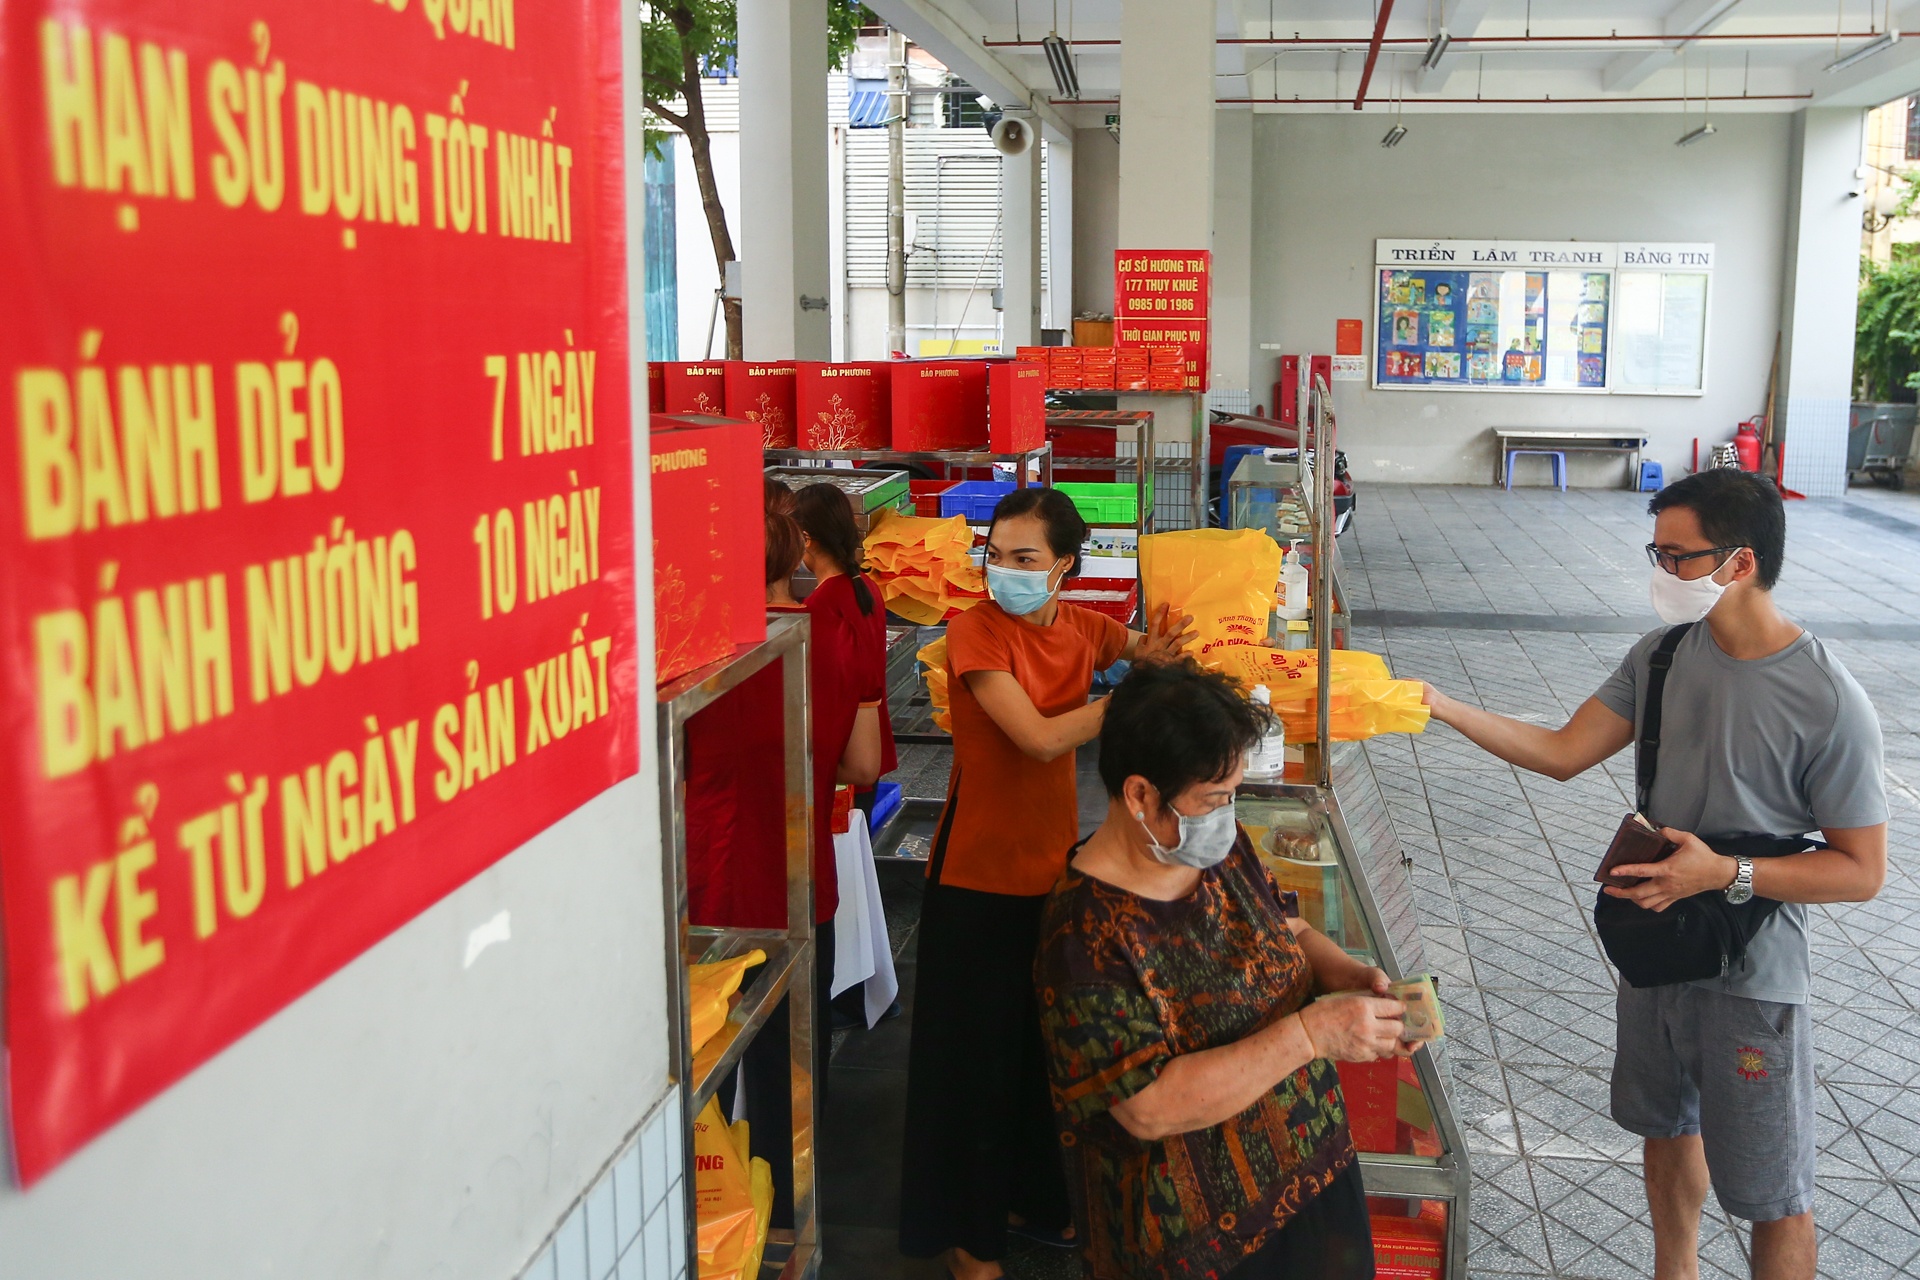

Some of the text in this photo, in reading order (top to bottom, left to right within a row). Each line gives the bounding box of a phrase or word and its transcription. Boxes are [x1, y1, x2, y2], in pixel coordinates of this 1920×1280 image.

[42, 20, 572, 249] HẠN SỬ DỤNG TỐT NHẤT
[1392, 243, 1603, 263] TRIỂN LÃM TRANH
[1624, 247, 1709, 265] BẢNG TIN
[1118, 256, 1205, 272] CƠ SỞ HƯƠNG TRÀ
[1125, 277, 1198, 294] 177 THỤY KHUÊ
[1128, 298, 1194, 310] 0985 00 1986
[1122, 327, 1200, 344] THỜI GIAN PHỤC VỤ
[686, 365, 705, 376] BẢO
[749, 366, 766, 376] BẢO
[821, 366, 871, 377] BẢO PHƯƠNG
[920, 367, 934, 378] BẢO
[486, 330, 595, 460] 7 NGÀY
[19, 313, 343, 539] BÁNH DẺO
[651, 448, 708, 474] PHƯƠNG
[474, 508, 516, 619] 10
[524, 471, 600, 603] NGÀY
[35, 517, 418, 779] BÁNH NƯỚNG
[53, 613, 610, 1013] KỂ TỪ NGÀY SẢN XUẤT
[1376, 1250, 1391, 1265] ẢO
